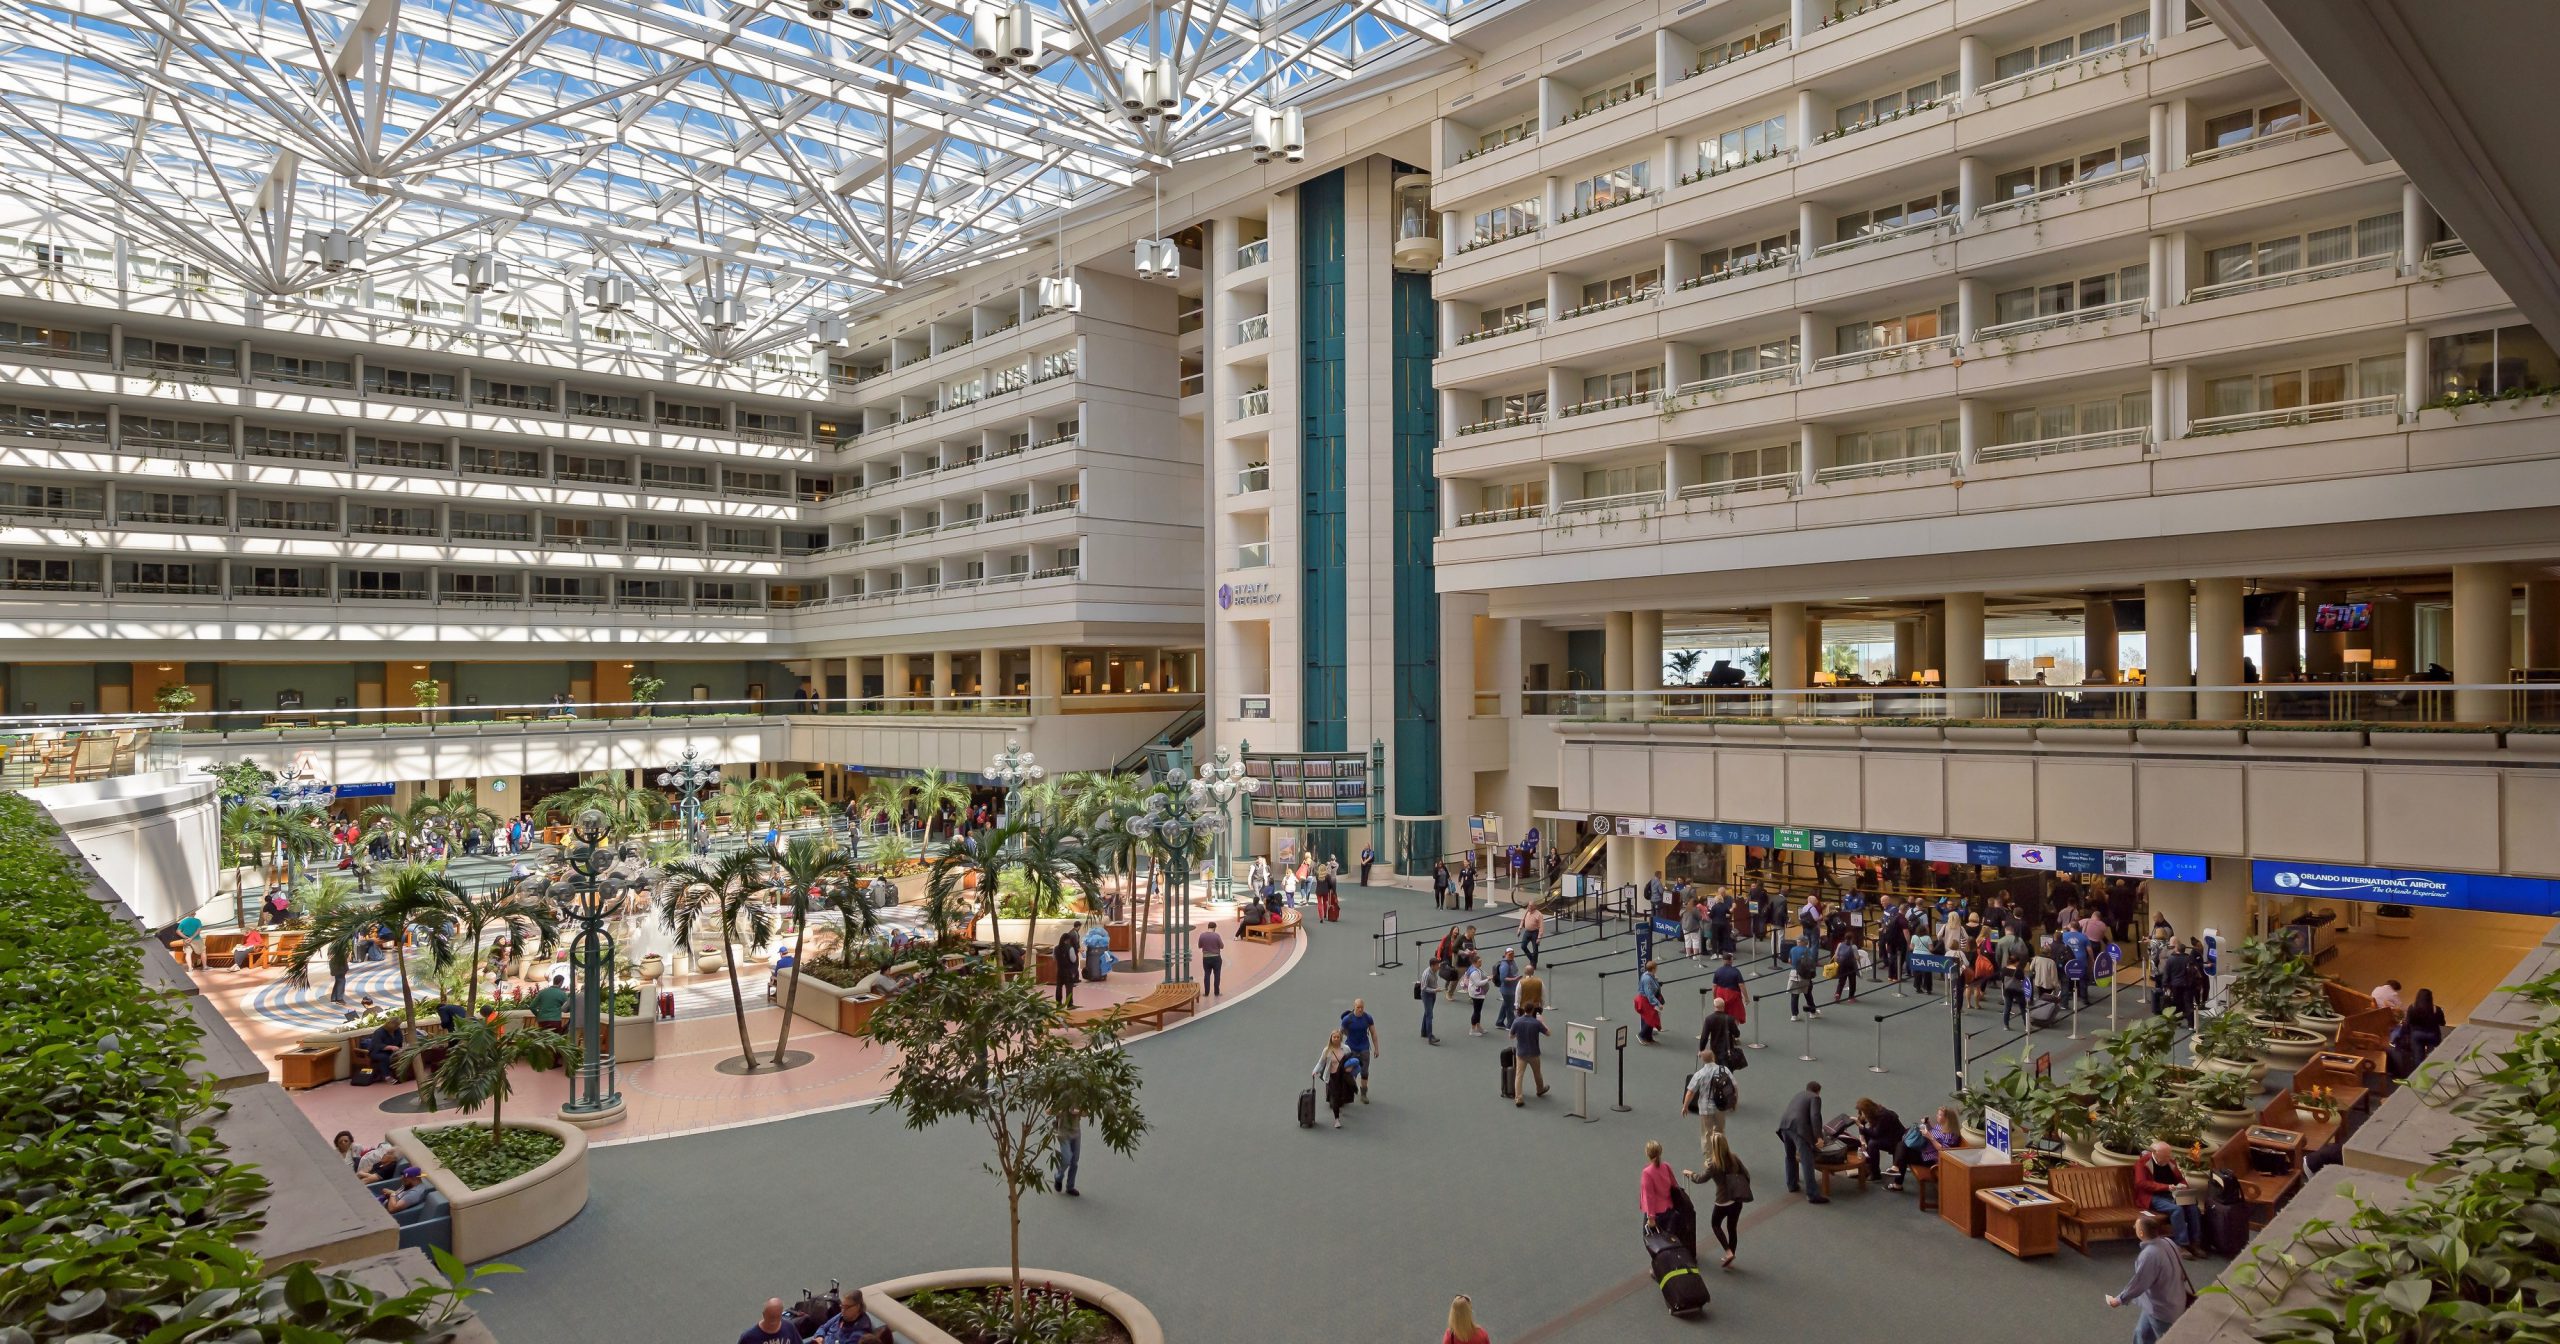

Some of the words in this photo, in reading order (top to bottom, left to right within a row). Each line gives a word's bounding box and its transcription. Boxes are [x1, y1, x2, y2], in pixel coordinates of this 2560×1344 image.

[1234, 583, 1269, 594] HYATT
[1234, 593, 1281, 605] REGENCY
[1729, 832, 1738, 840] 70
[1756, 834, 1770, 842] 129
[1832, 839, 1858, 849] Gates
[1871, 842, 1882, 850] 70
[1903, 844, 1920, 853] 129
[2301, 873, 2340, 881] ORLANDO
[2342, 876, 2407, 887] INTERNATIONAL
[2410, 881, 2447, 890] AIRPORT
[2412, 889, 2447, 898] Experience
[1911, 958, 1926, 967] TSA
[1927, 960, 1940, 968] Pre
